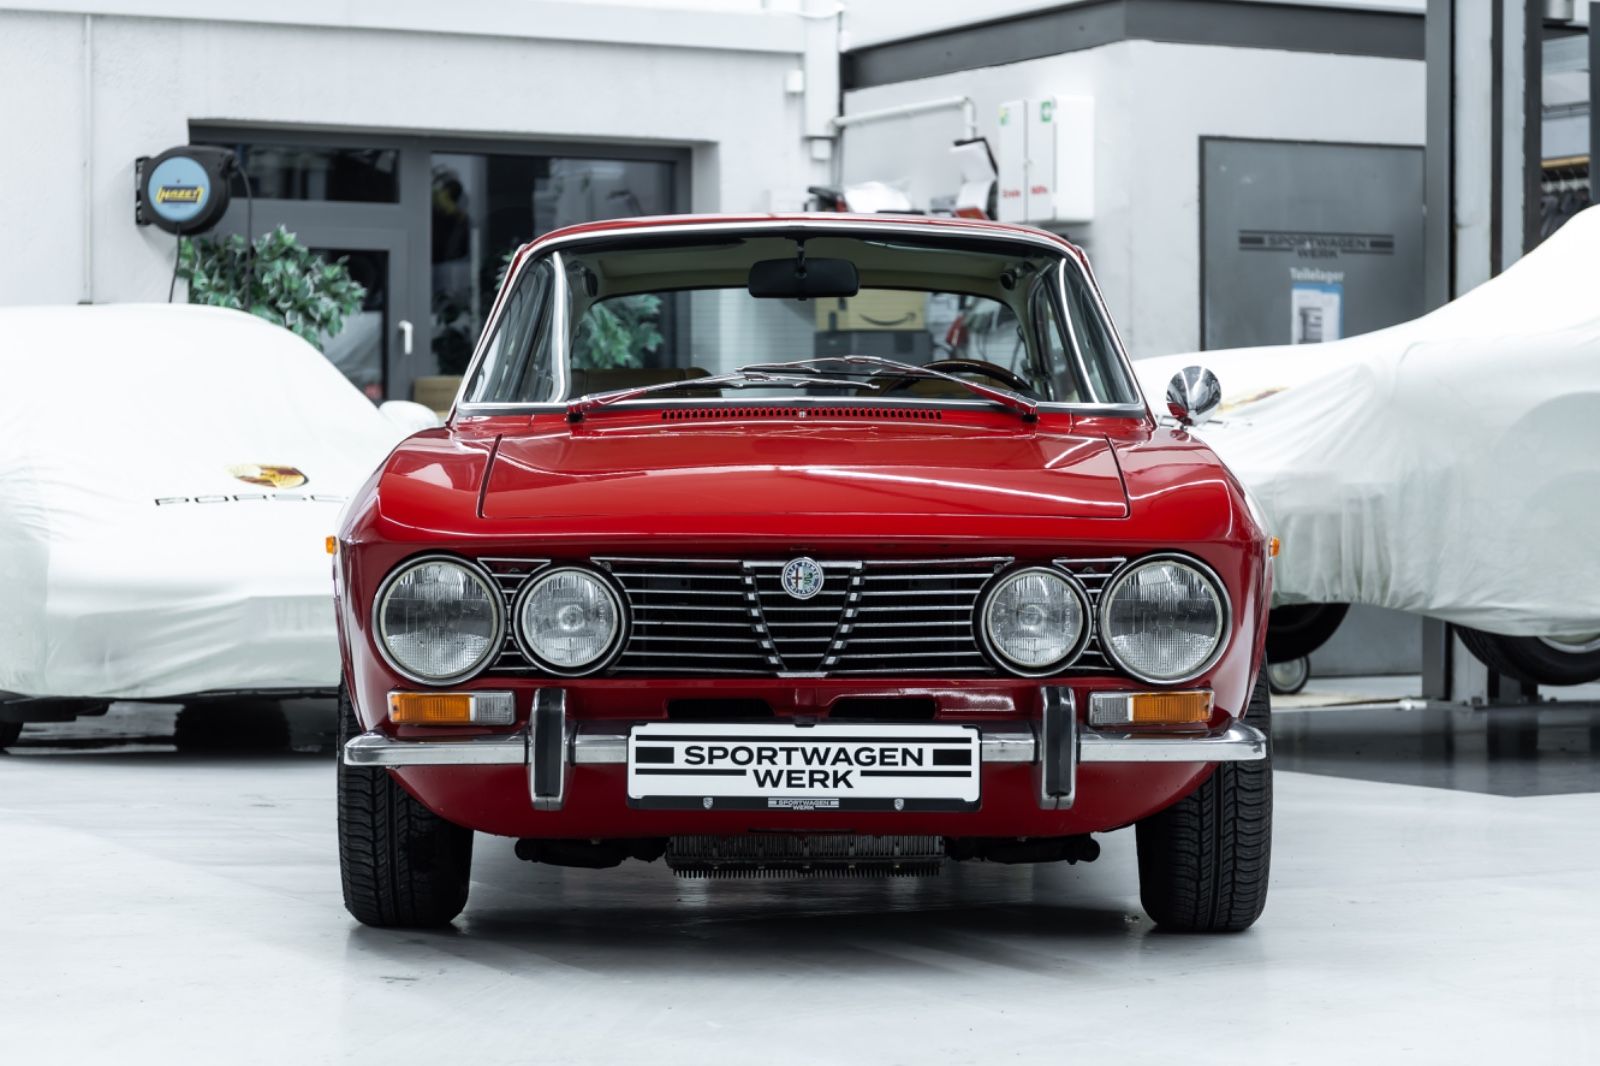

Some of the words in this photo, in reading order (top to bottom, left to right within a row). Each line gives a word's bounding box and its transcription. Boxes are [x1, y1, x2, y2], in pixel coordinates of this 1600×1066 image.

[1268, 233, 1367, 249] SPORTWAGEN
[1297, 249, 1339, 259] WERK
[1290, 267, 1345, 284] Teilelager
[684, 745, 924, 767] SPORTWAGEN
[753, 769, 854, 789] WERK
